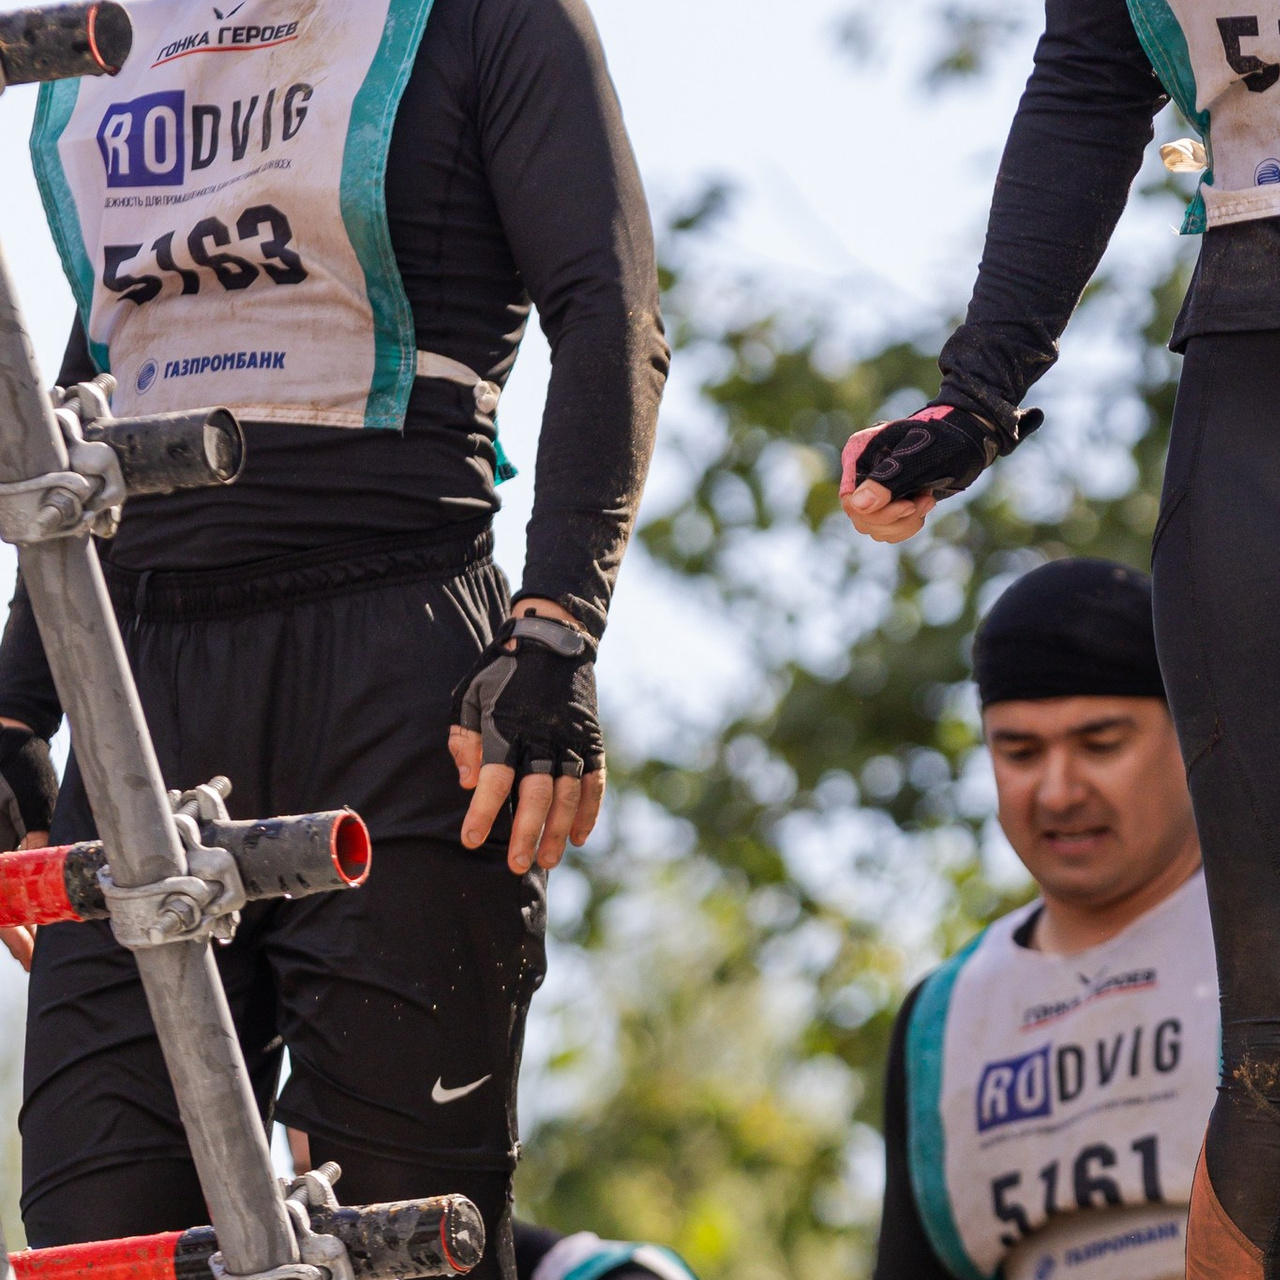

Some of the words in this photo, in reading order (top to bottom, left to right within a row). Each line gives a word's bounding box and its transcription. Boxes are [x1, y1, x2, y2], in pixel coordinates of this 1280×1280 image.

[156, 30, 211, 62] ГОНКА
[217, 20, 300, 45] ГЕРОЕВ
[105, 82, 315, 177] RODVIG
[102, 202, 310, 307] 5163
[163, 350, 287, 380] ГАЗПРОМБАНК
[981, 1017, 1183, 1123] RODVIG
[990, 1133, 1166, 1247] 5161
